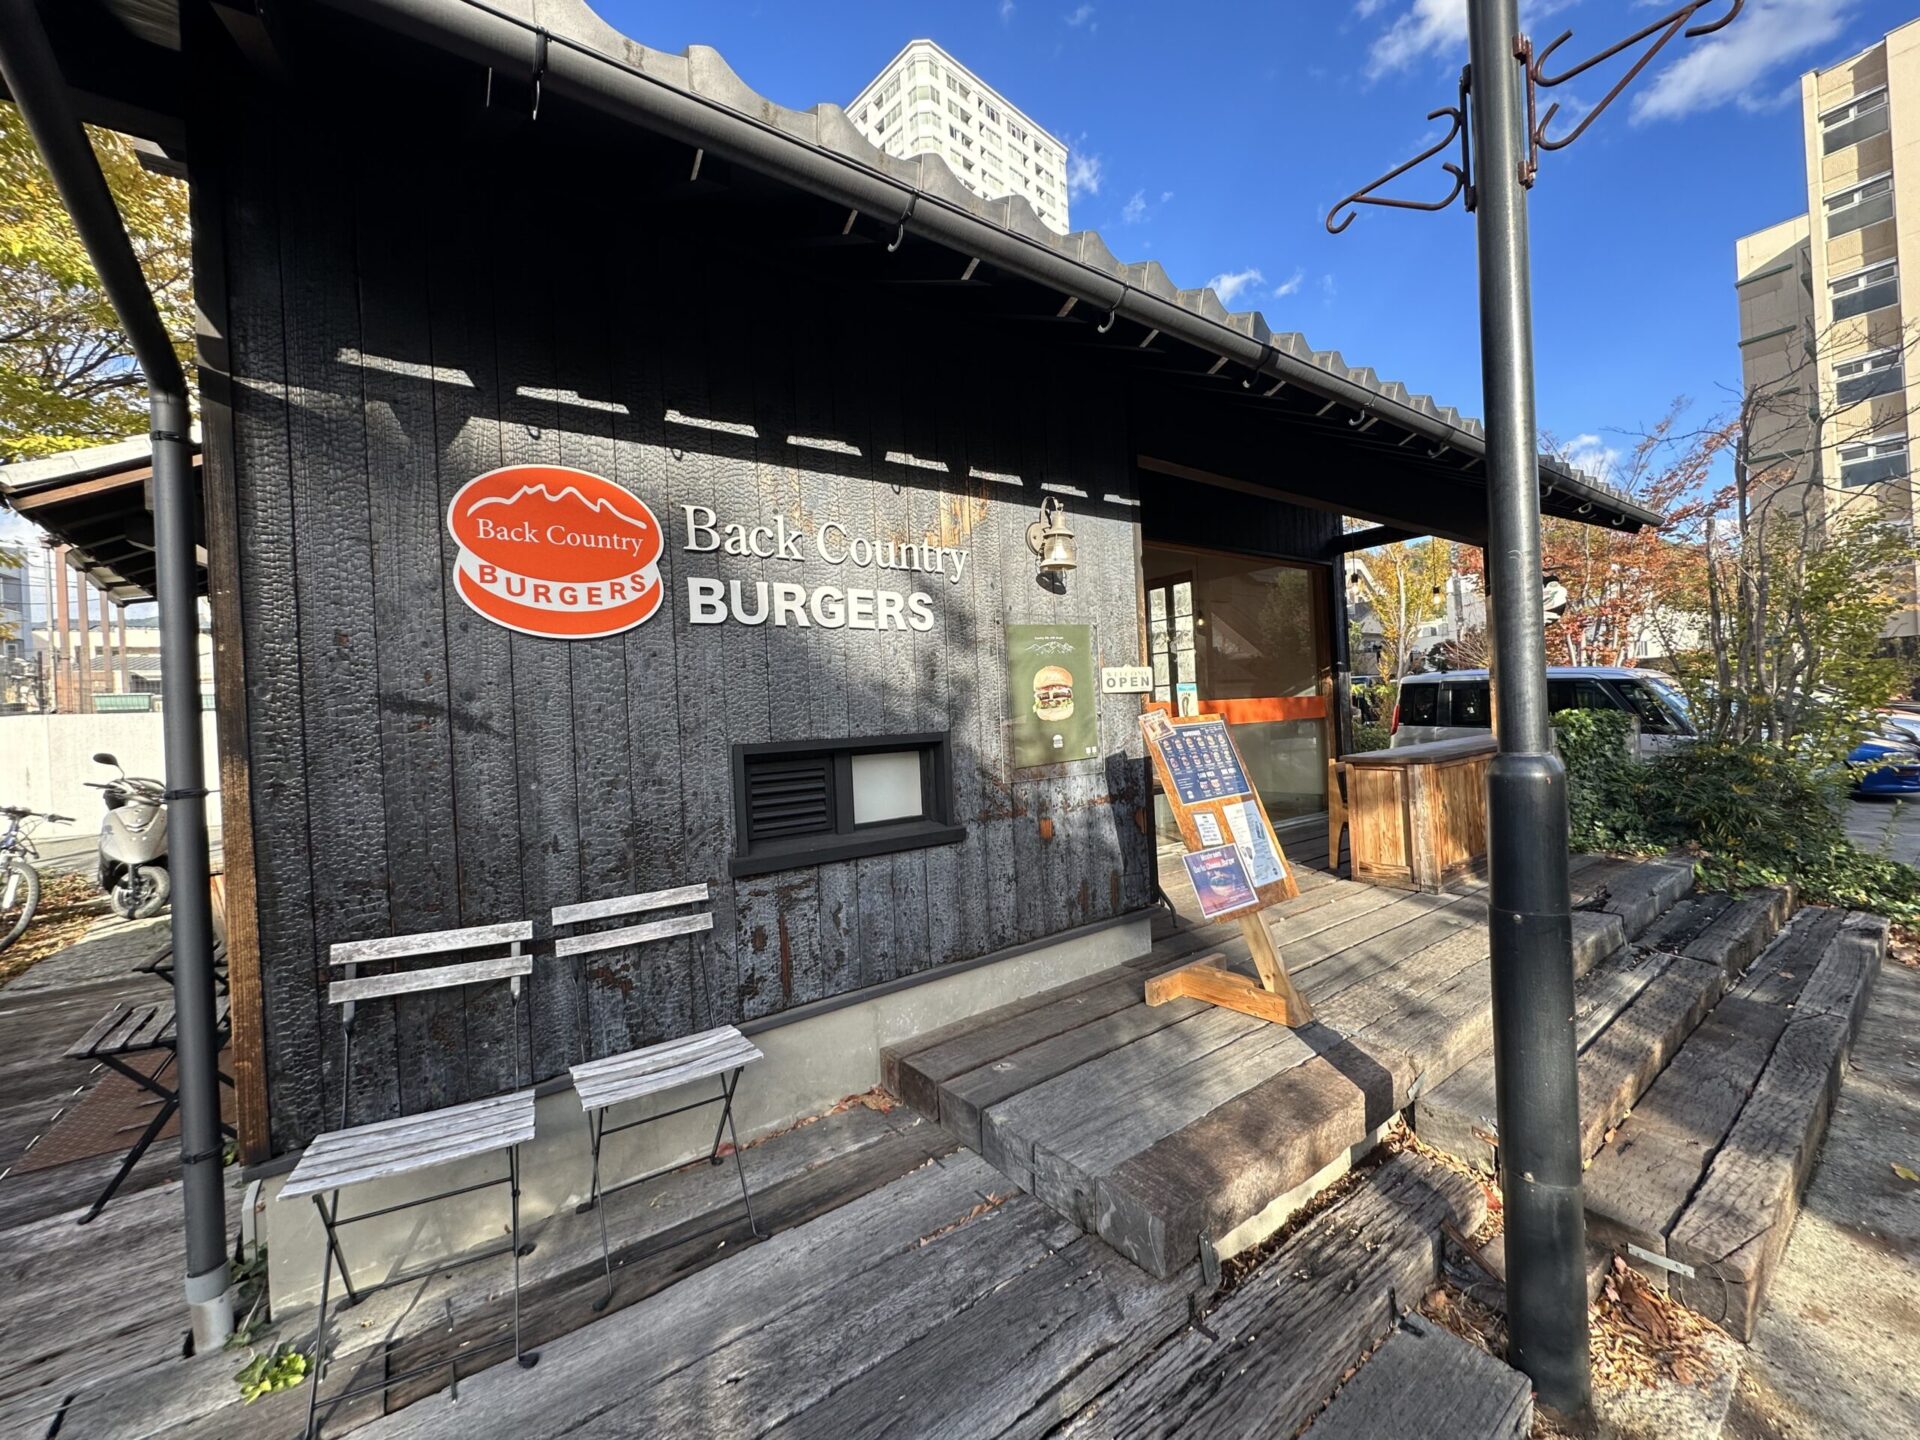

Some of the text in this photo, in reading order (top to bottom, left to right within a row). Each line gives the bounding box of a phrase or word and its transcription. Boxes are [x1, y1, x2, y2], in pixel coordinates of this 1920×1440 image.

[477, 518, 644, 557] Back Country
[680, 504, 969, 583] Back Country
[478, 564, 646, 606] BURGERS
[687, 576, 935, 631] BURGERS
[1106, 677, 1150, 688] OPEN
